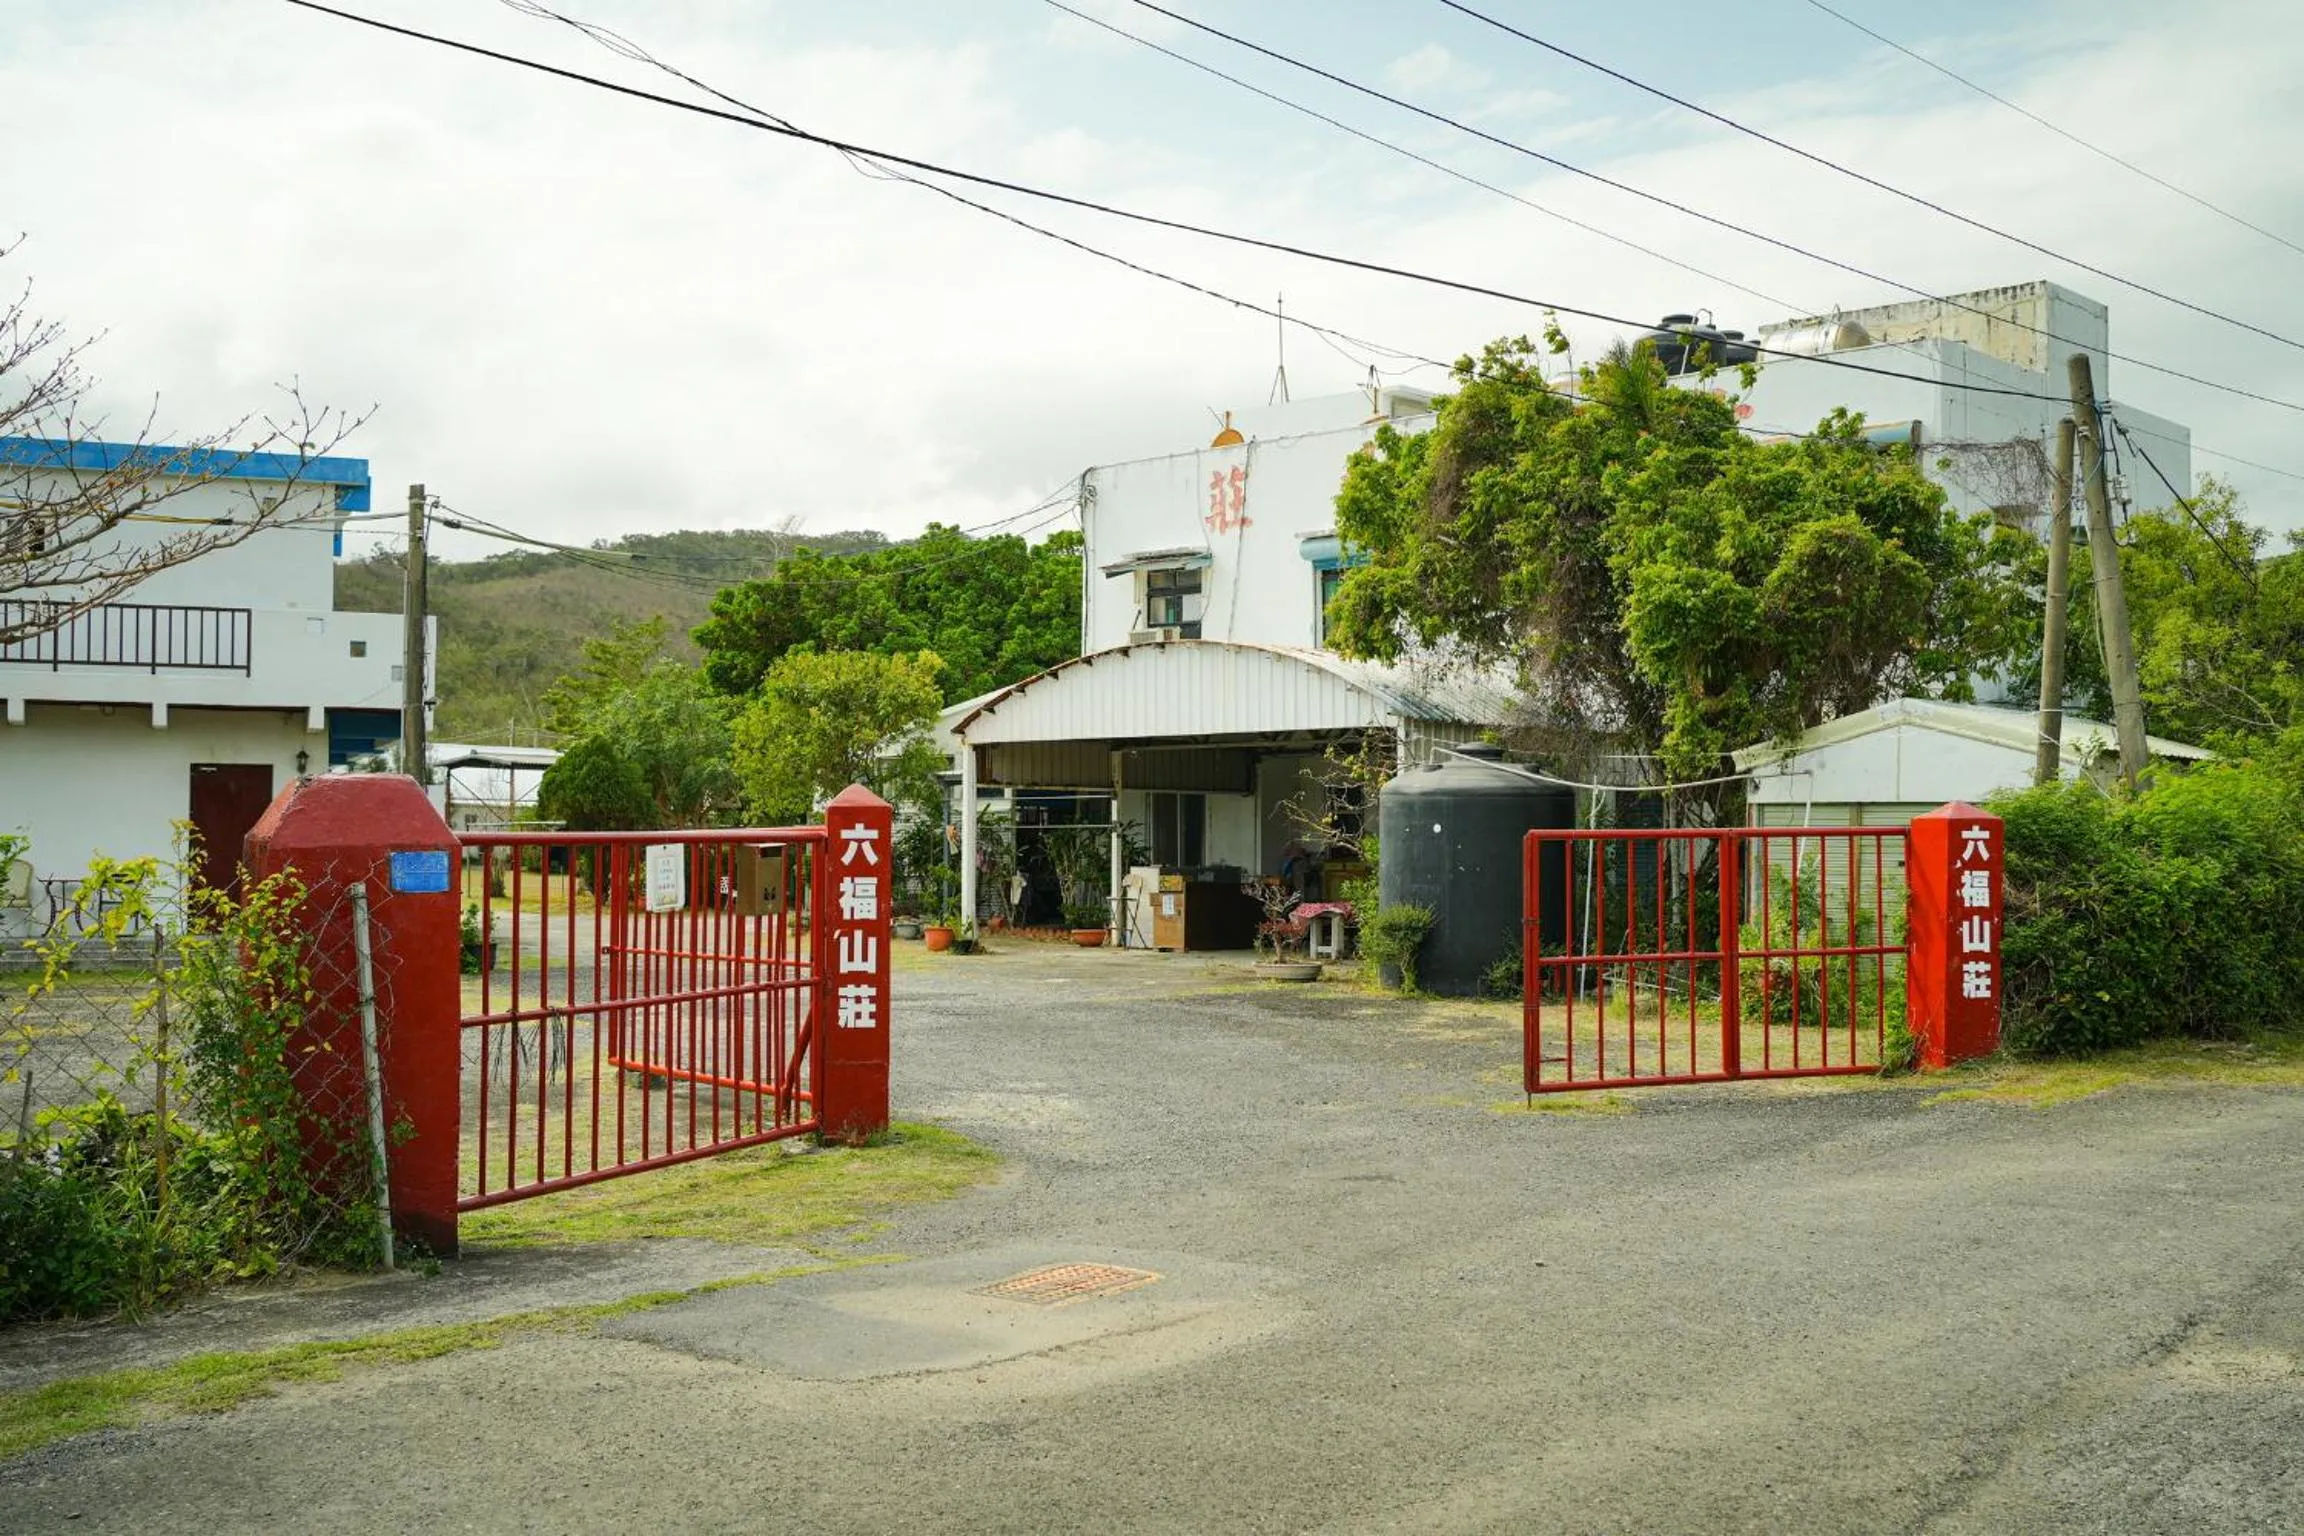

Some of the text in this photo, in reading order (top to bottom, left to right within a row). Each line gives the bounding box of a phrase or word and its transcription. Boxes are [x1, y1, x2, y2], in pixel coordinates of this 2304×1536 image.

[838, 822, 879, 1029] 六福山莊
[1960, 825, 1992, 999] 六福山莊
